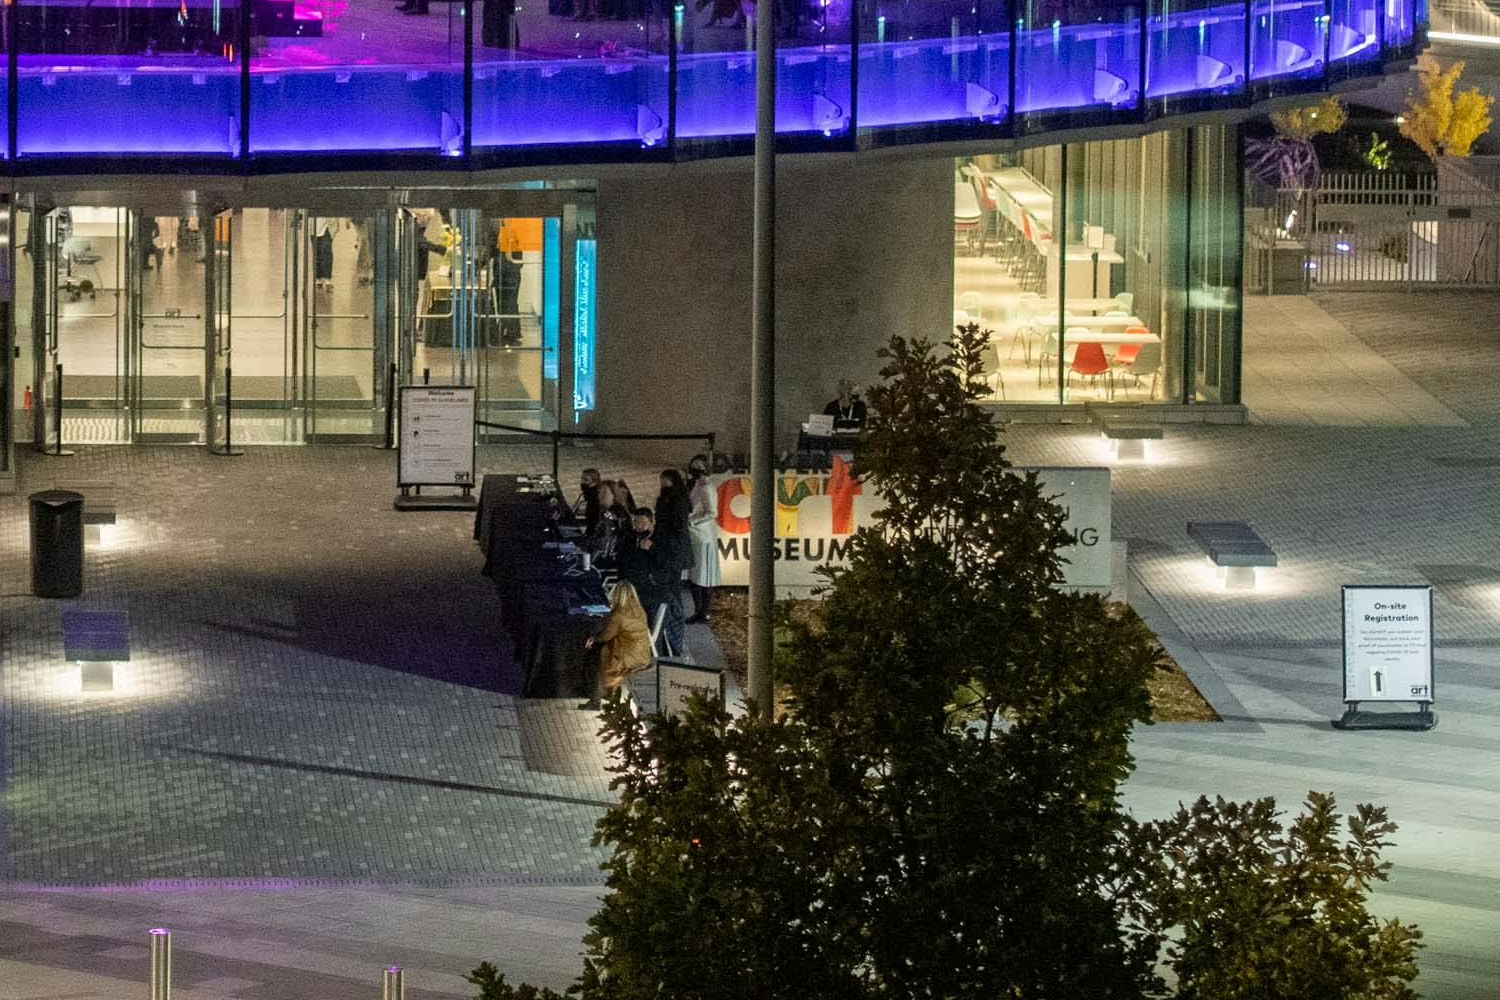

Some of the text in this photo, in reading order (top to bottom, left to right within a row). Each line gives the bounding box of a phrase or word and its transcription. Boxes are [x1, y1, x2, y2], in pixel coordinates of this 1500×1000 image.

[1373, 602, 1407, 610] On-site
[1364, 614, 1419, 624] Registration
[1411, 685, 1428, 694] art
